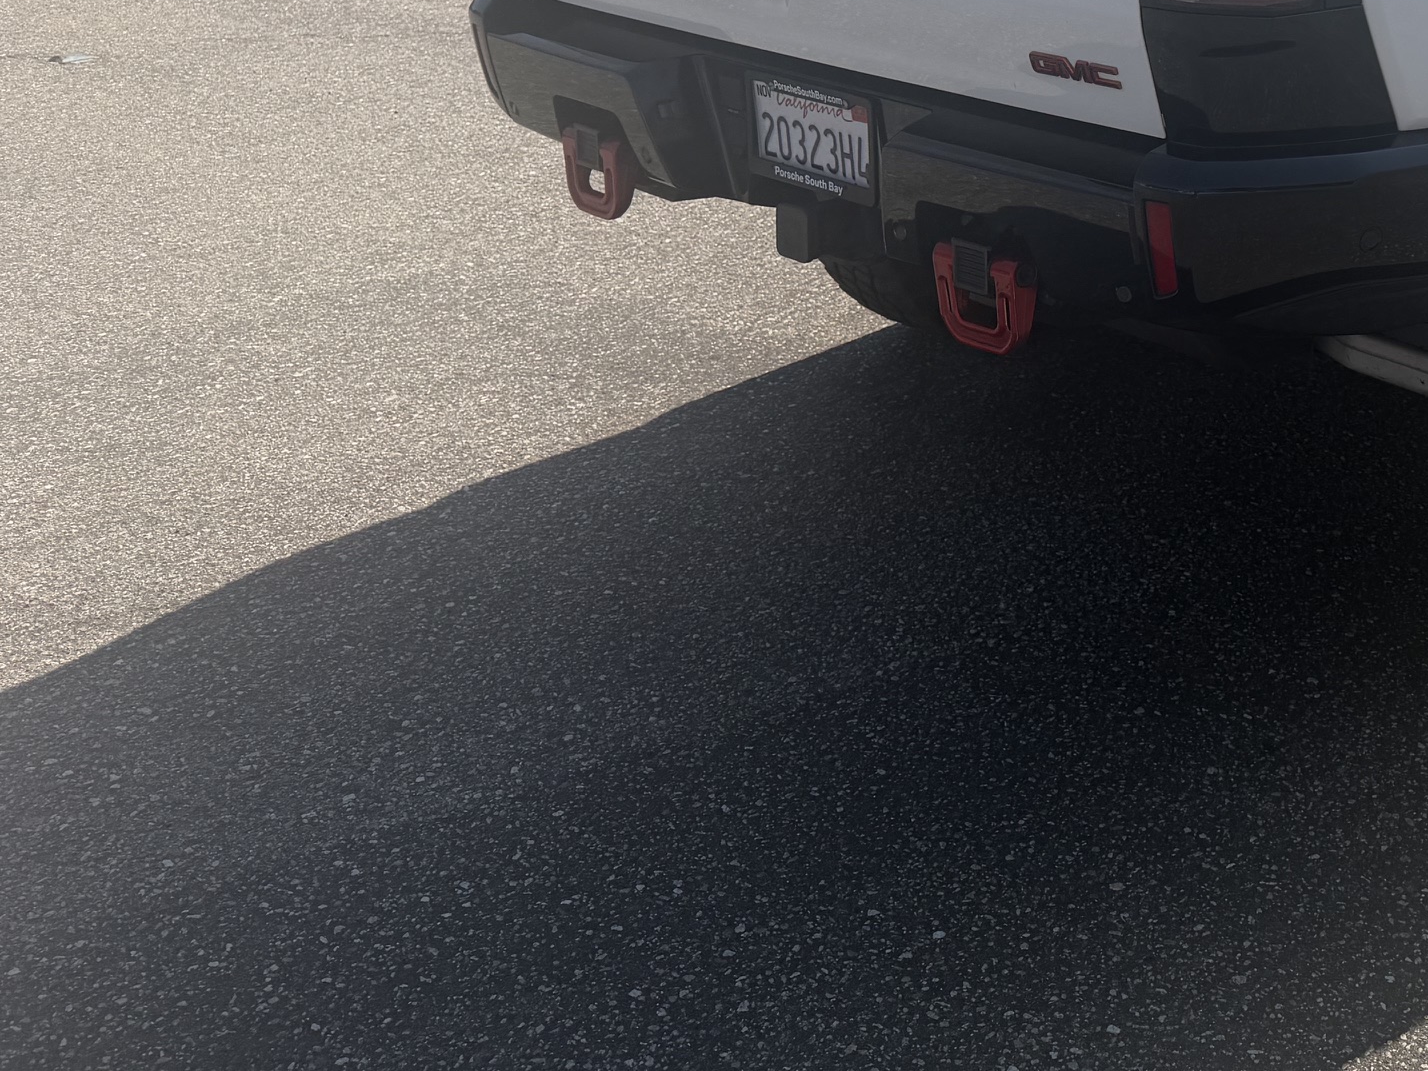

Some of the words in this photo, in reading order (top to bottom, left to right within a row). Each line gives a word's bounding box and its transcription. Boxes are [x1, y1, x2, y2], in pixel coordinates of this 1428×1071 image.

[1028, 50, 1123, 90] GMC
[756, 83, 772, 98] NOV
[773, 80, 843, 106] PorscheSouthBay.com
[774, 165, 804, 183] Porsche
[804, 176, 828, 190] South
[828, 181, 843, 196] Bay
